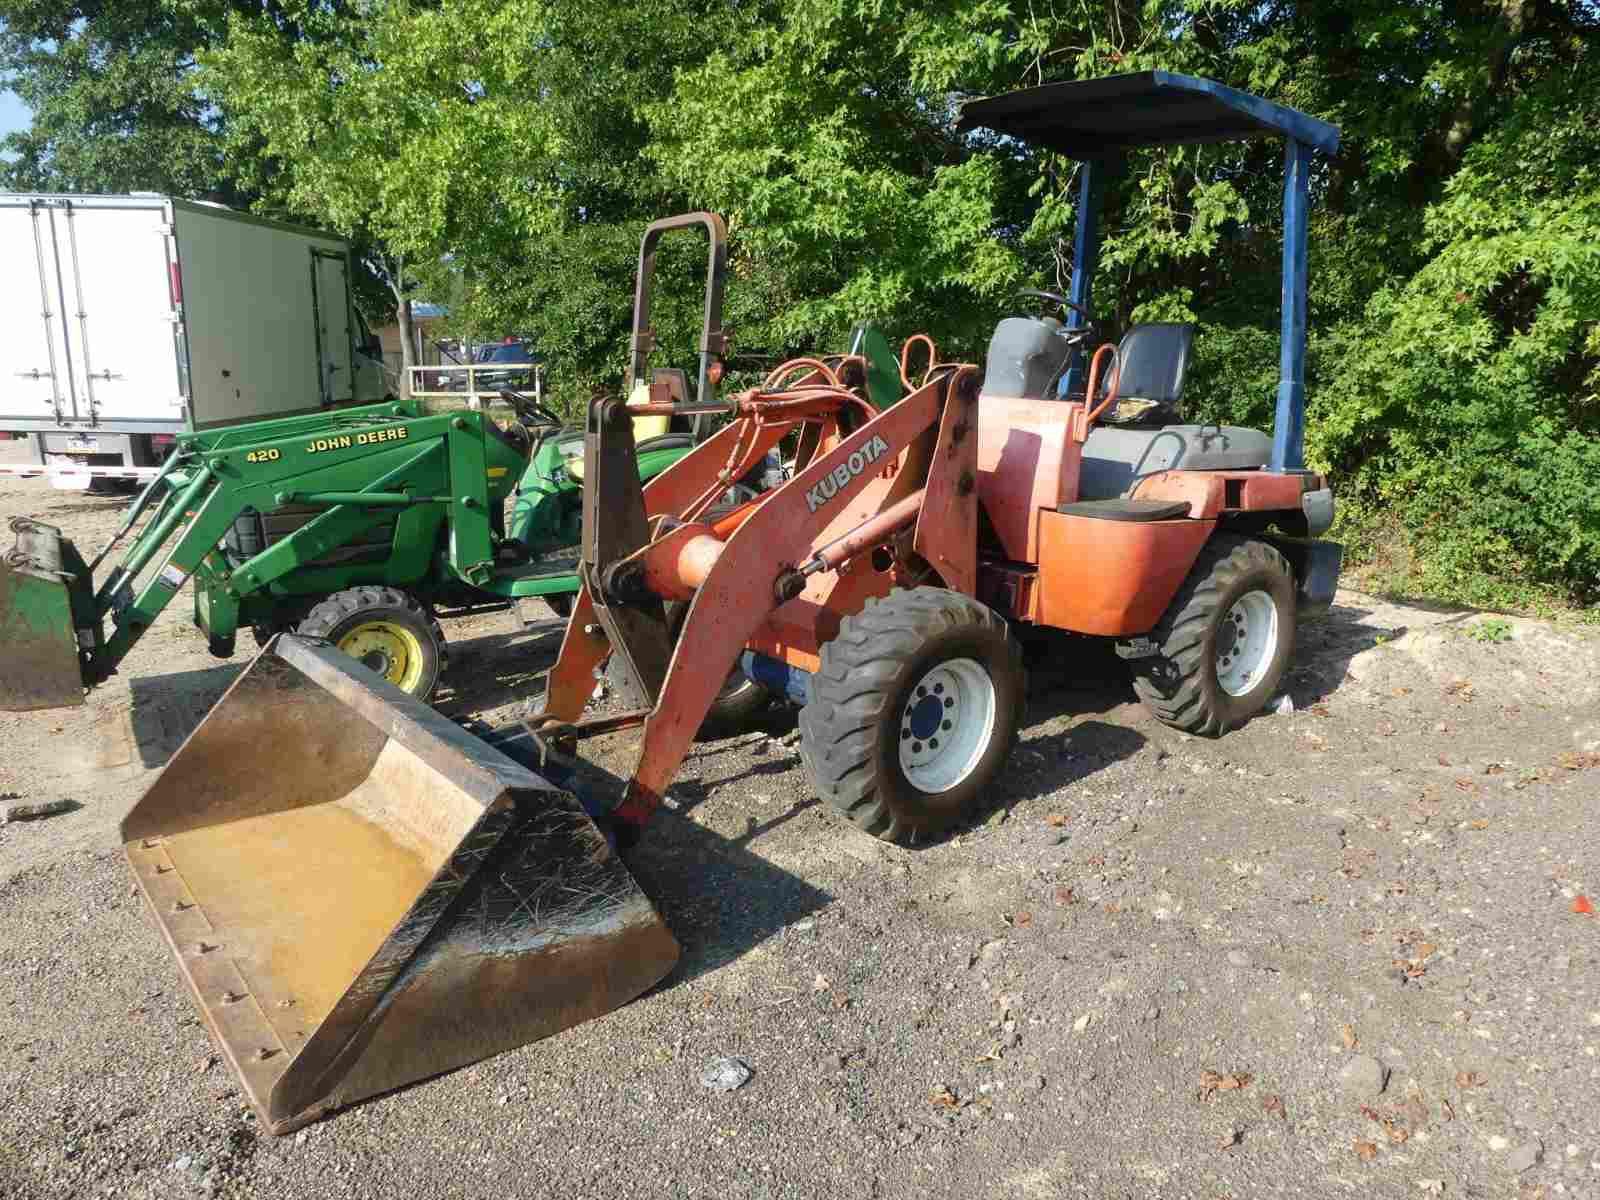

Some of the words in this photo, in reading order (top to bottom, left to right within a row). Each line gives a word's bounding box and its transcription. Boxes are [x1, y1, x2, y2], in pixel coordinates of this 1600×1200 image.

[305, 436, 352, 454] JOHN
[356, 427, 408, 445] DEERE
[246, 448, 281, 463] 420
[805, 434, 889, 513] KUBOTA
